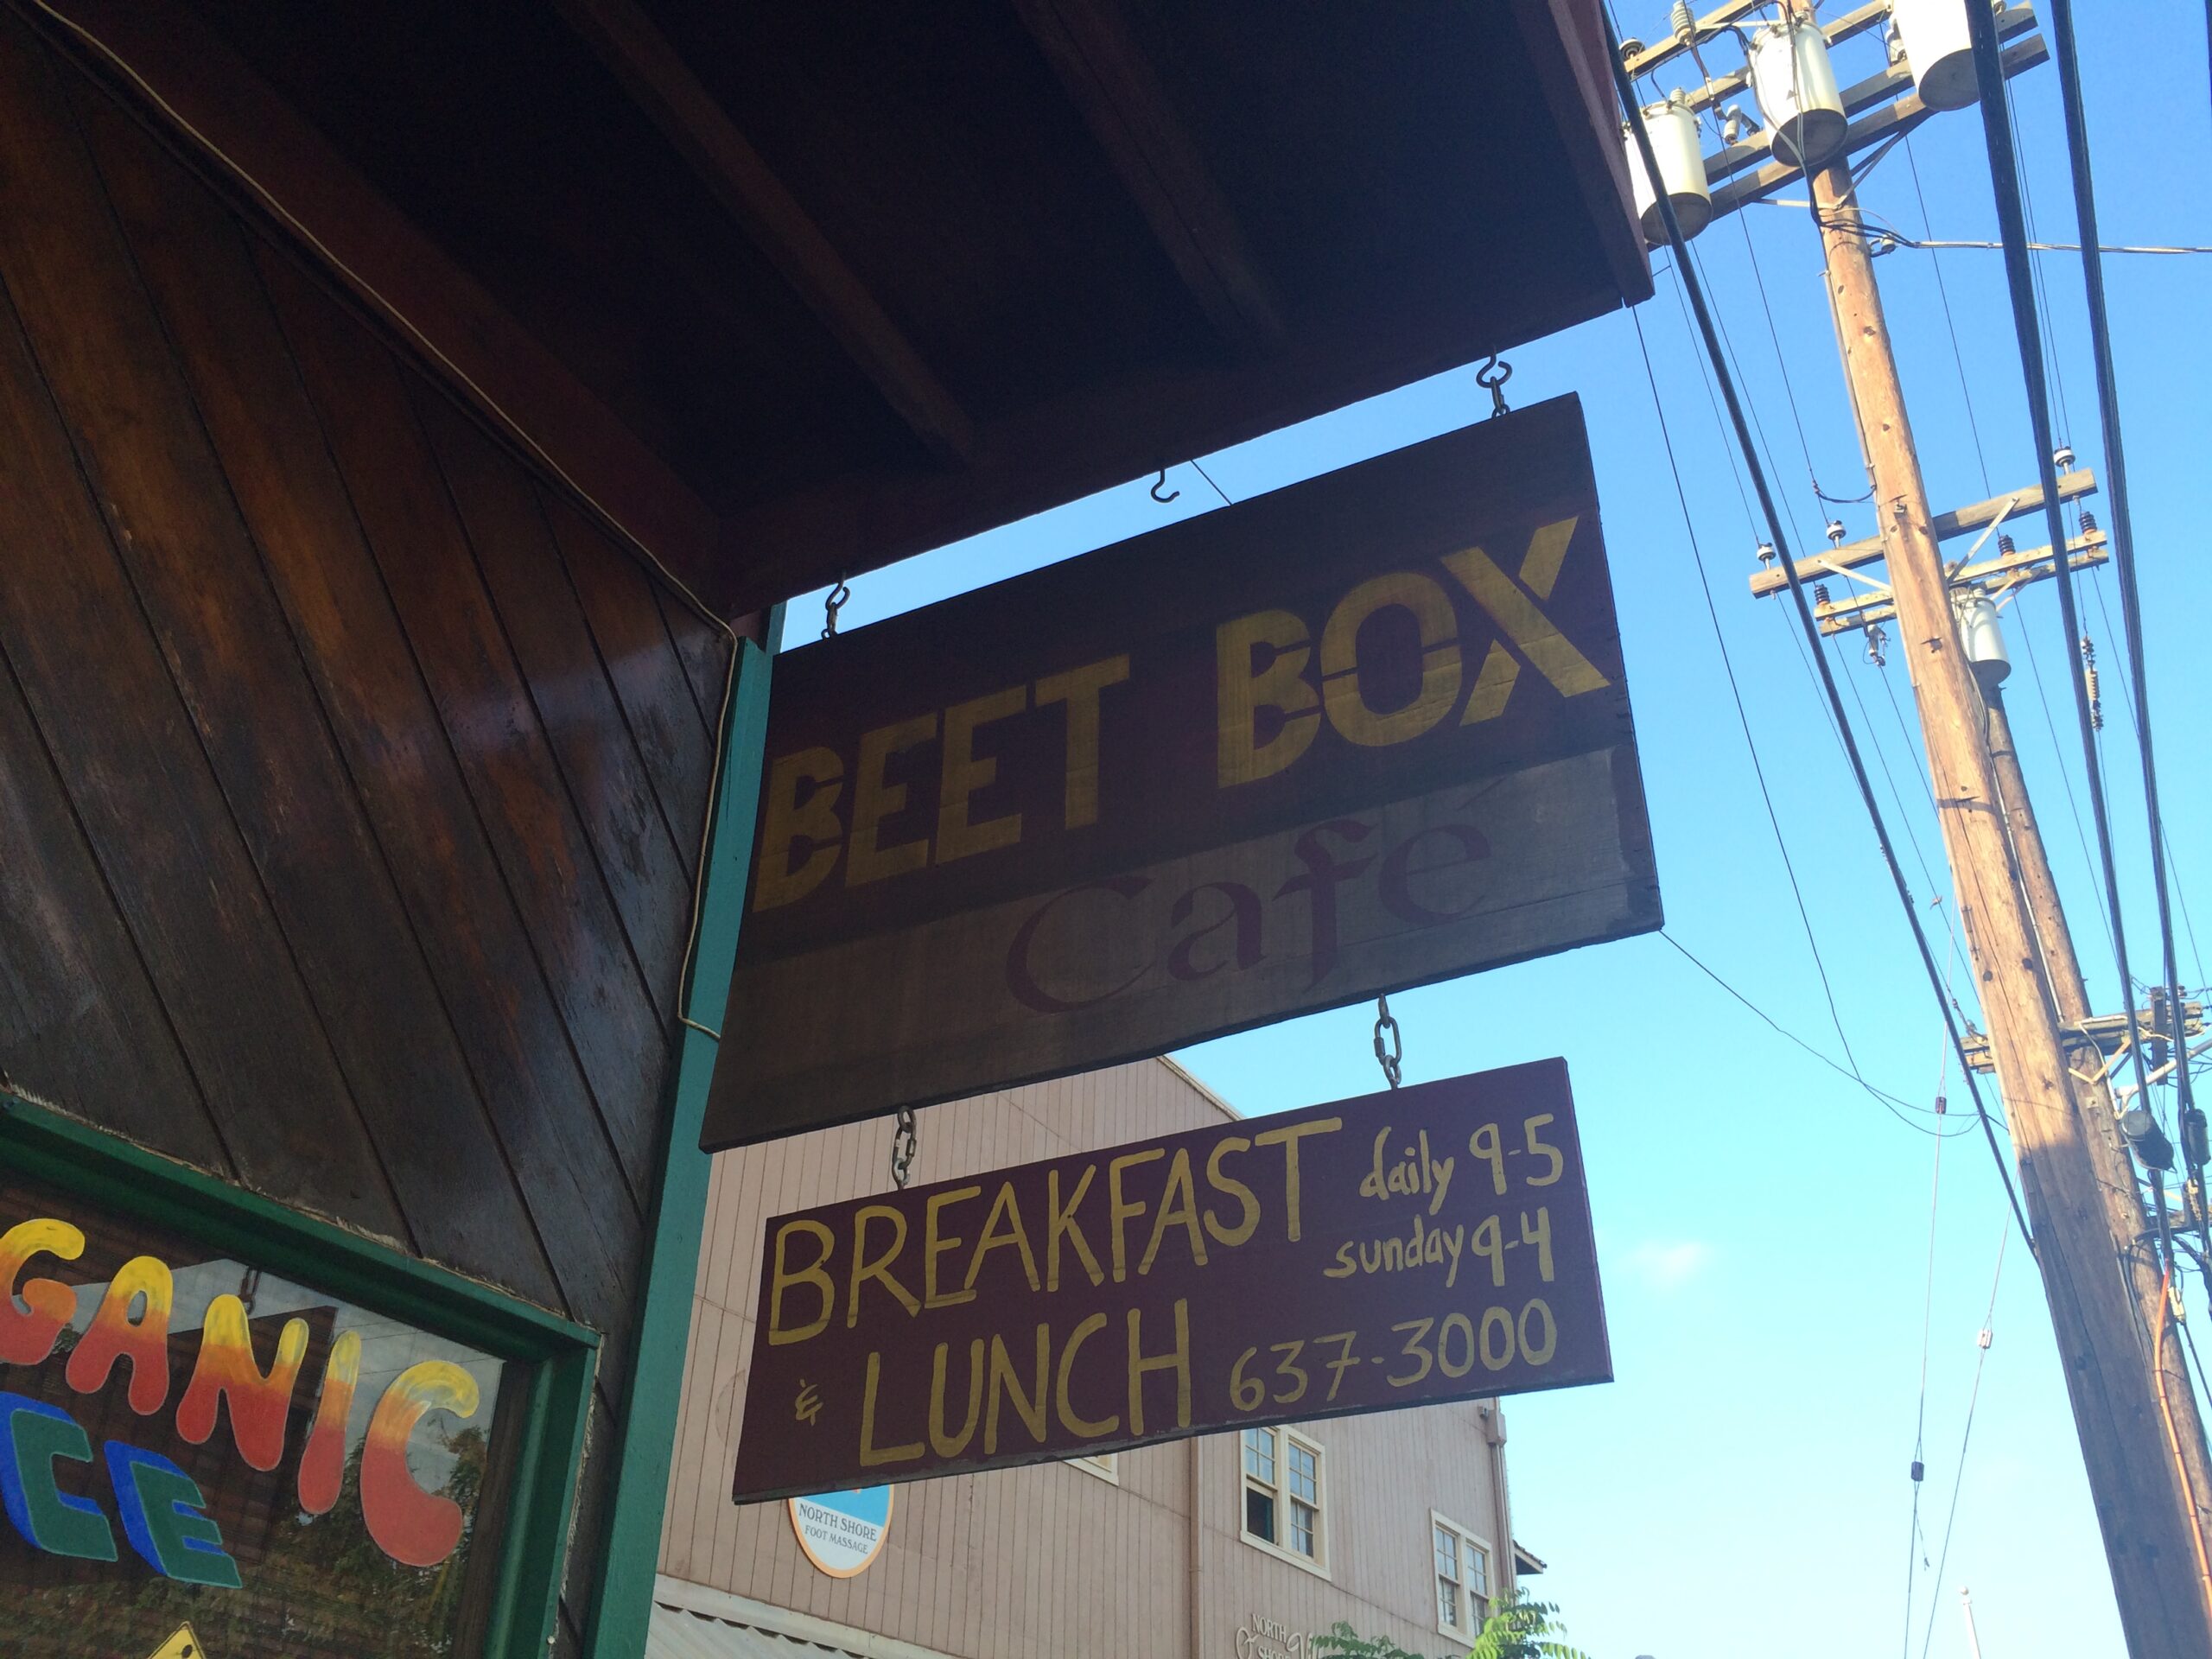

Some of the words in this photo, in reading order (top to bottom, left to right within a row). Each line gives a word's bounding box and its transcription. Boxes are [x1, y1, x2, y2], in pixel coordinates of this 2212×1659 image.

[753, 654, 1130, 914] BEET
[1217, 516, 1611, 790] BOX
[1358, 1126, 1455, 1216] daily
[1469, 1112, 1564, 1195] 9-5
[767, 1116, 1343, 1346] BREAKFAST
[1323, 1214, 1465, 1287] sunday
[1471, 1206, 1554, 1287] 9-4
[0, 1217, 480, 1567] GANIC
[860, 1300, 1192, 1467] LUNCH
[1229, 1298, 1557, 1411] 637-3000
[799, 1503, 838, 1528] NORTH
[841, 1518, 877, 1541] SHORE
[804, 1525, 828, 1540] FOOT
[830, 1534, 868, 1554] MASSAGE
[1252, 1613, 1287, 1643] NORTH
